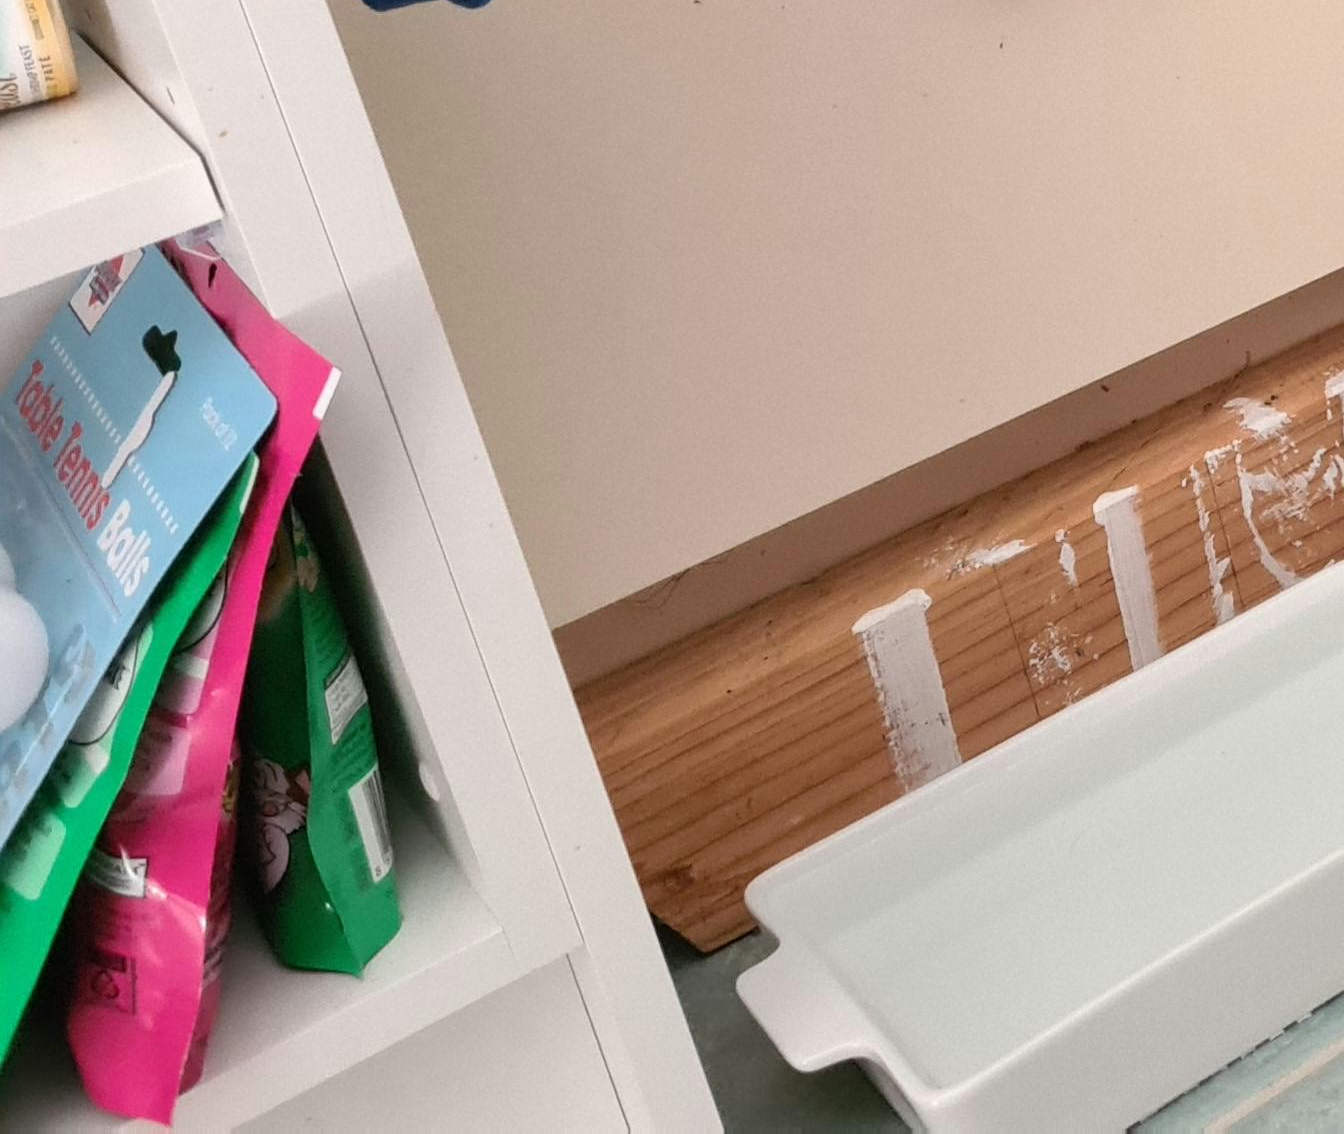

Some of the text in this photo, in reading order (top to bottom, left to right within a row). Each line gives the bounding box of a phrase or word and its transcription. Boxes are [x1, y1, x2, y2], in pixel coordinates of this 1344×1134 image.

[16, 359, 150, 597] Table Tennis Balls
